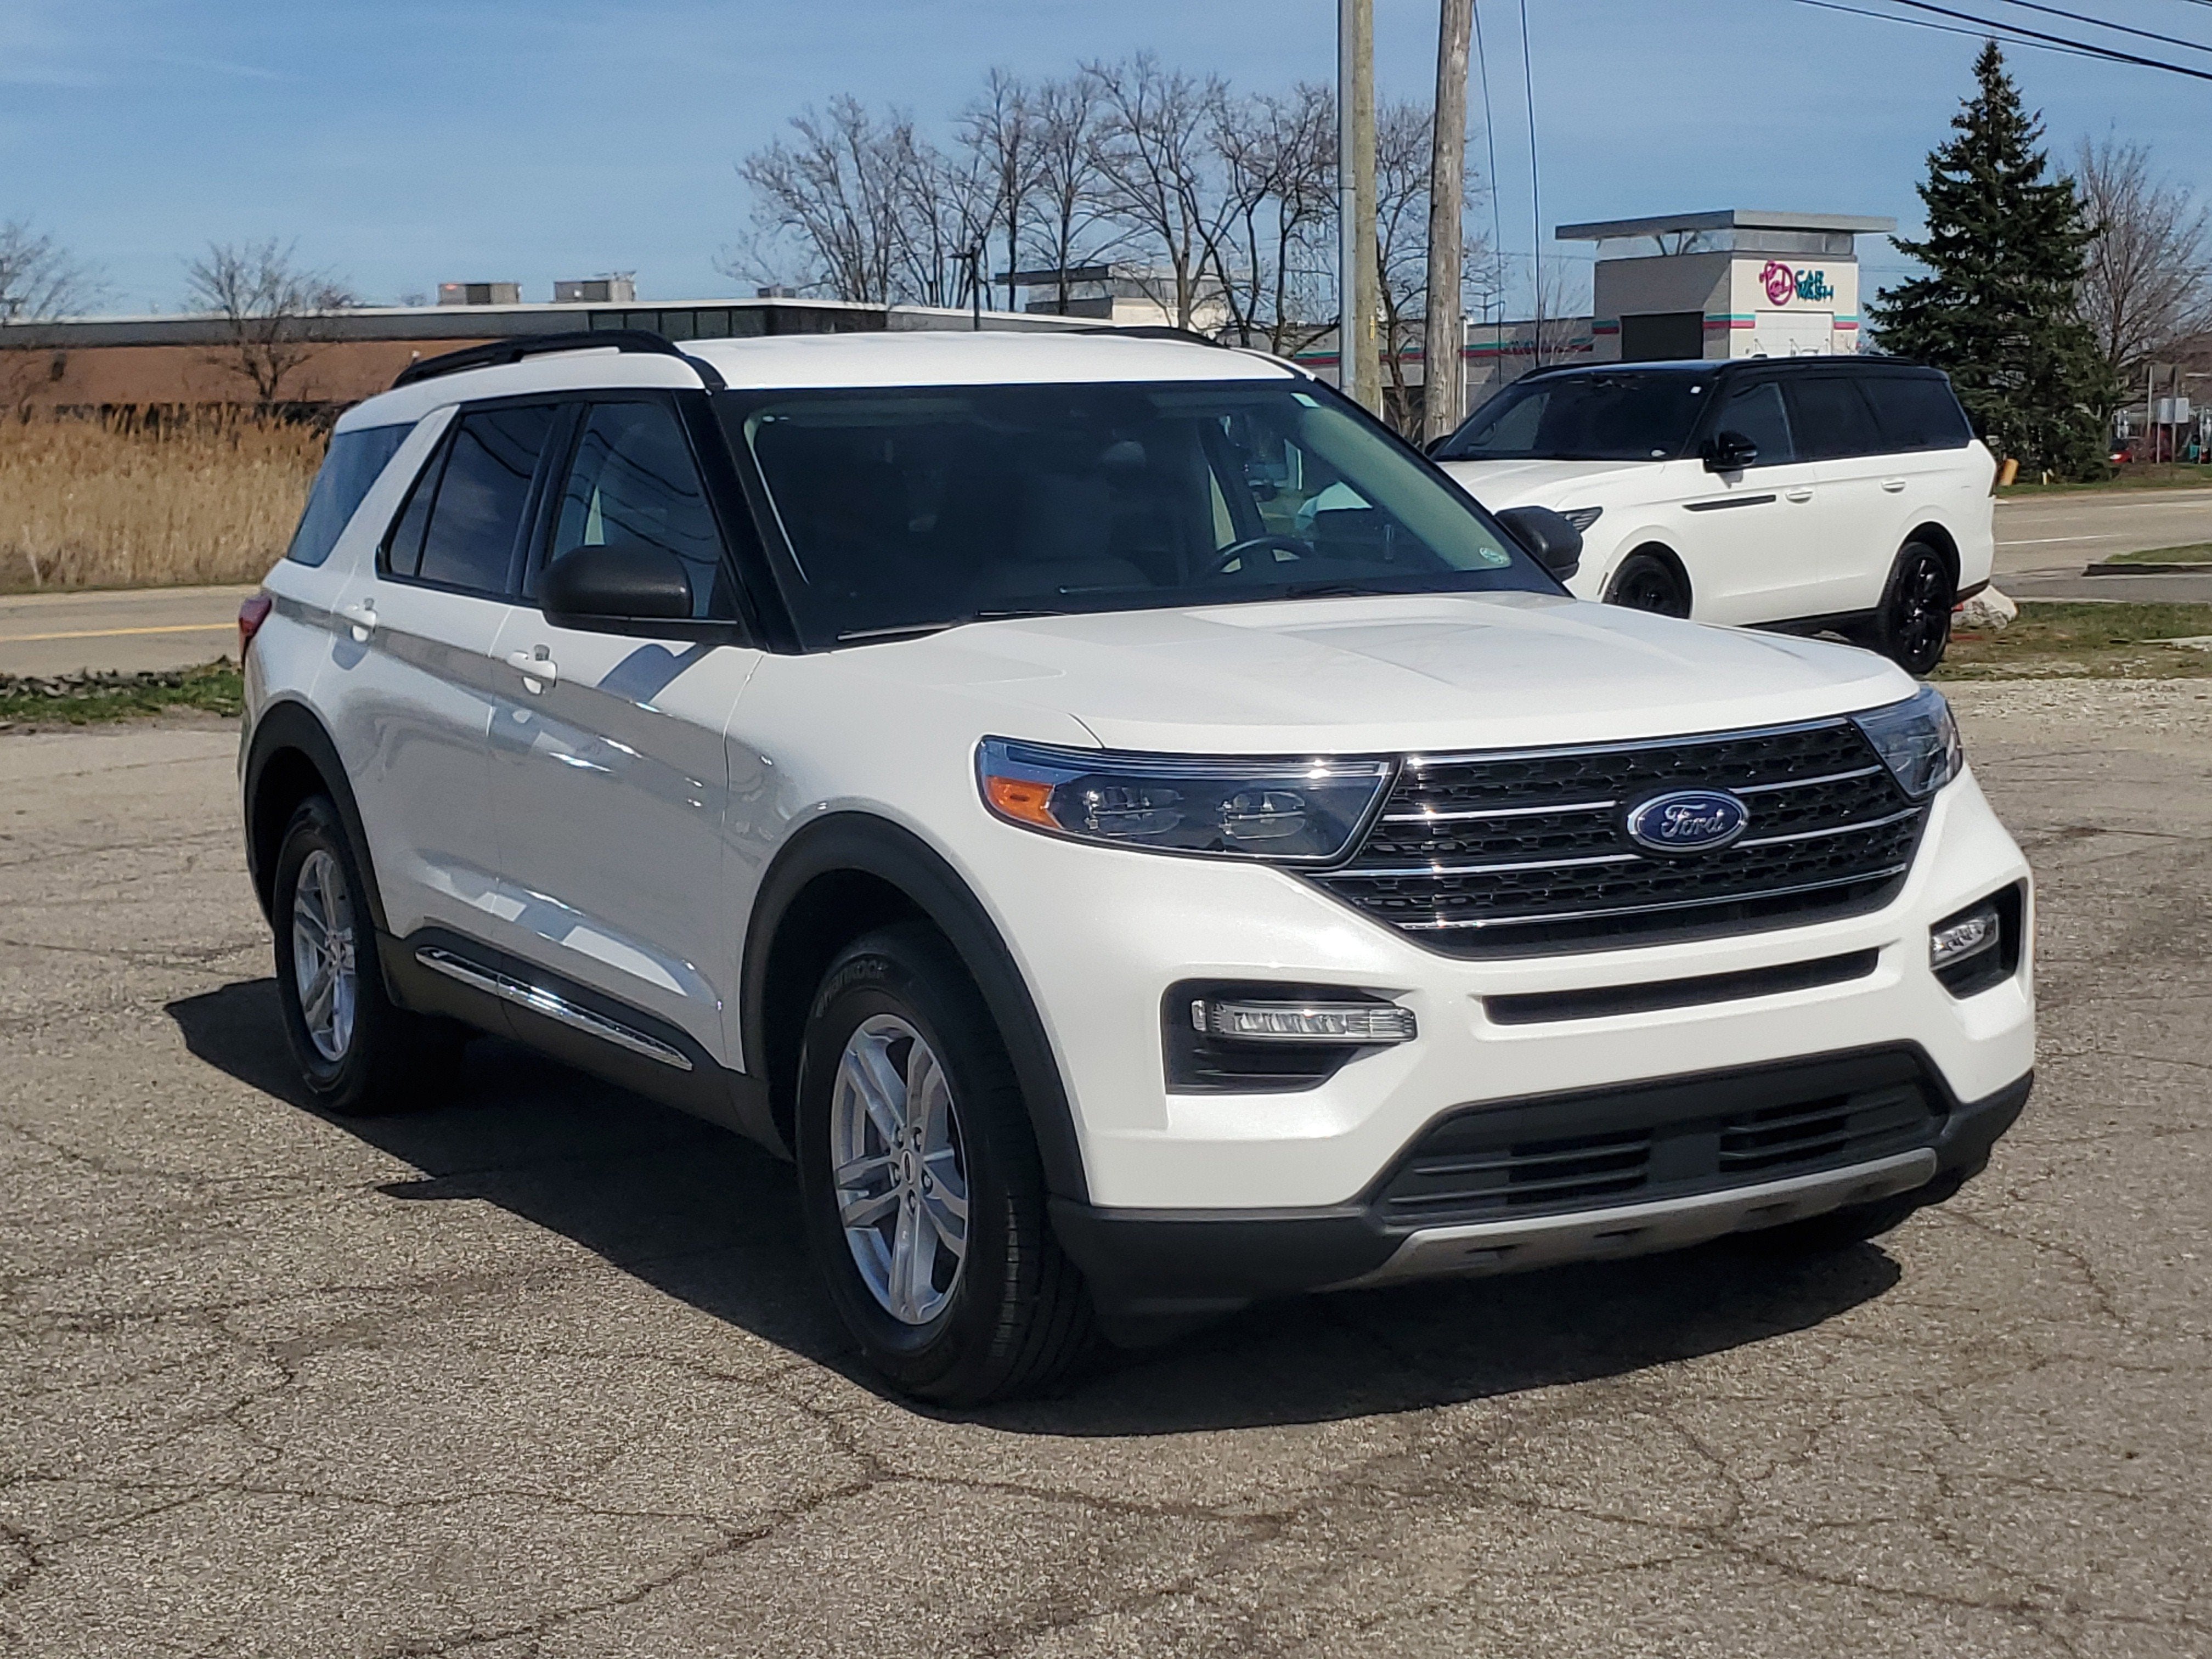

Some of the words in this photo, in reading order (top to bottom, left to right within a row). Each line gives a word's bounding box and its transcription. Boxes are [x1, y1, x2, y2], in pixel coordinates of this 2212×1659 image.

[1795, 269, 1824, 285] CAR
[1794, 283, 1834, 301] WASH
[1661, 803, 1724, 838] Ford
